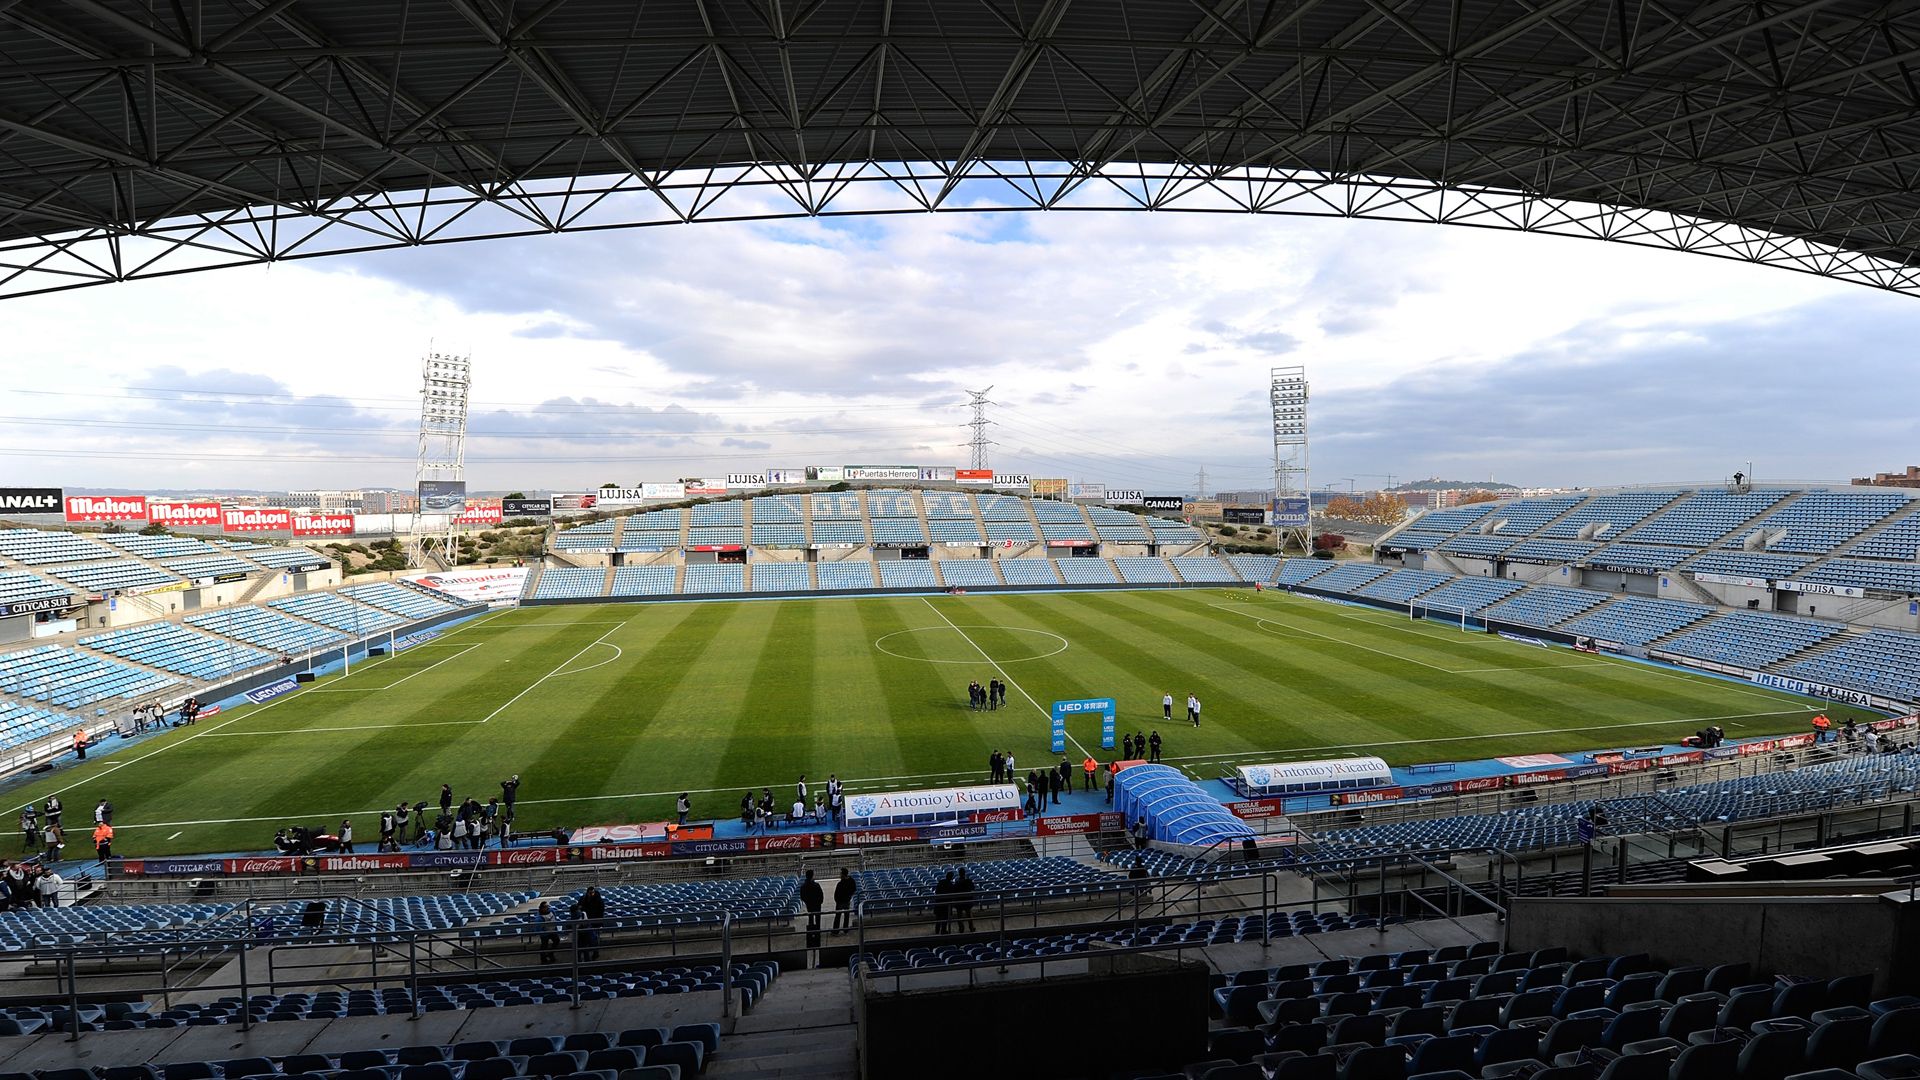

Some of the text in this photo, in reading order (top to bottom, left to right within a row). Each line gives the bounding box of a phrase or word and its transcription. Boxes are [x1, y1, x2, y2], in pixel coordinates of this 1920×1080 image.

[728, 475, 765, 484] LUJISA
[860, 470, 917, 478] Puertas Herrero
[994, 475, 1029, 484] LUJISA
[600, 490, 641, 499] LUJISA
[1107, 491, 1142, 500] LUJISA
[69, 498, 144, 514] Mahou
[1145, 500, 1181, 508] CANAL+
[151, 504, 218, 519] Mahou
[226, 510, 288, 525] Mahou
[294, 516, 351, 530] Mahou
[1606, 564, 1649, 575] CITYCAR SUR
[1799, 583, 1836, 595] LUJISA
[12, 598, 68, 613] CITYCAR SUR
[1757, 674, 1869, 705] IMELCO LUJISA
[1059, 703, 1082, 711] UED
[1273, 761, 1384, 778] Antonio y Ricardo
[880, 789, 1014, 809] Antonio y Ricardo
[1347, 791, 1383, 804] Mahou
[1234, 801, 1259, 810] BRICOLAJE
[1043, 816, 1072, 825] BRICOLAJE
[939, 827, 985, 837] CITYCAR SUR
[765, 837, 801, 849] Coca-Cola
[843, 832, 891, 845] Mahou
[592, 847, 643, 859] Mahou
[695, 842, 745, 852] CITYCAR SUR
[434, 854, 487, 864] CITYCAR SUR
[509, 850, 546, 863] Coca-Cola
[168, 863, 222, 872] CITYCAR SUR
[243, 859, 284, 872] Coca-Cola
[327, 857, 380, 870] Mahou
